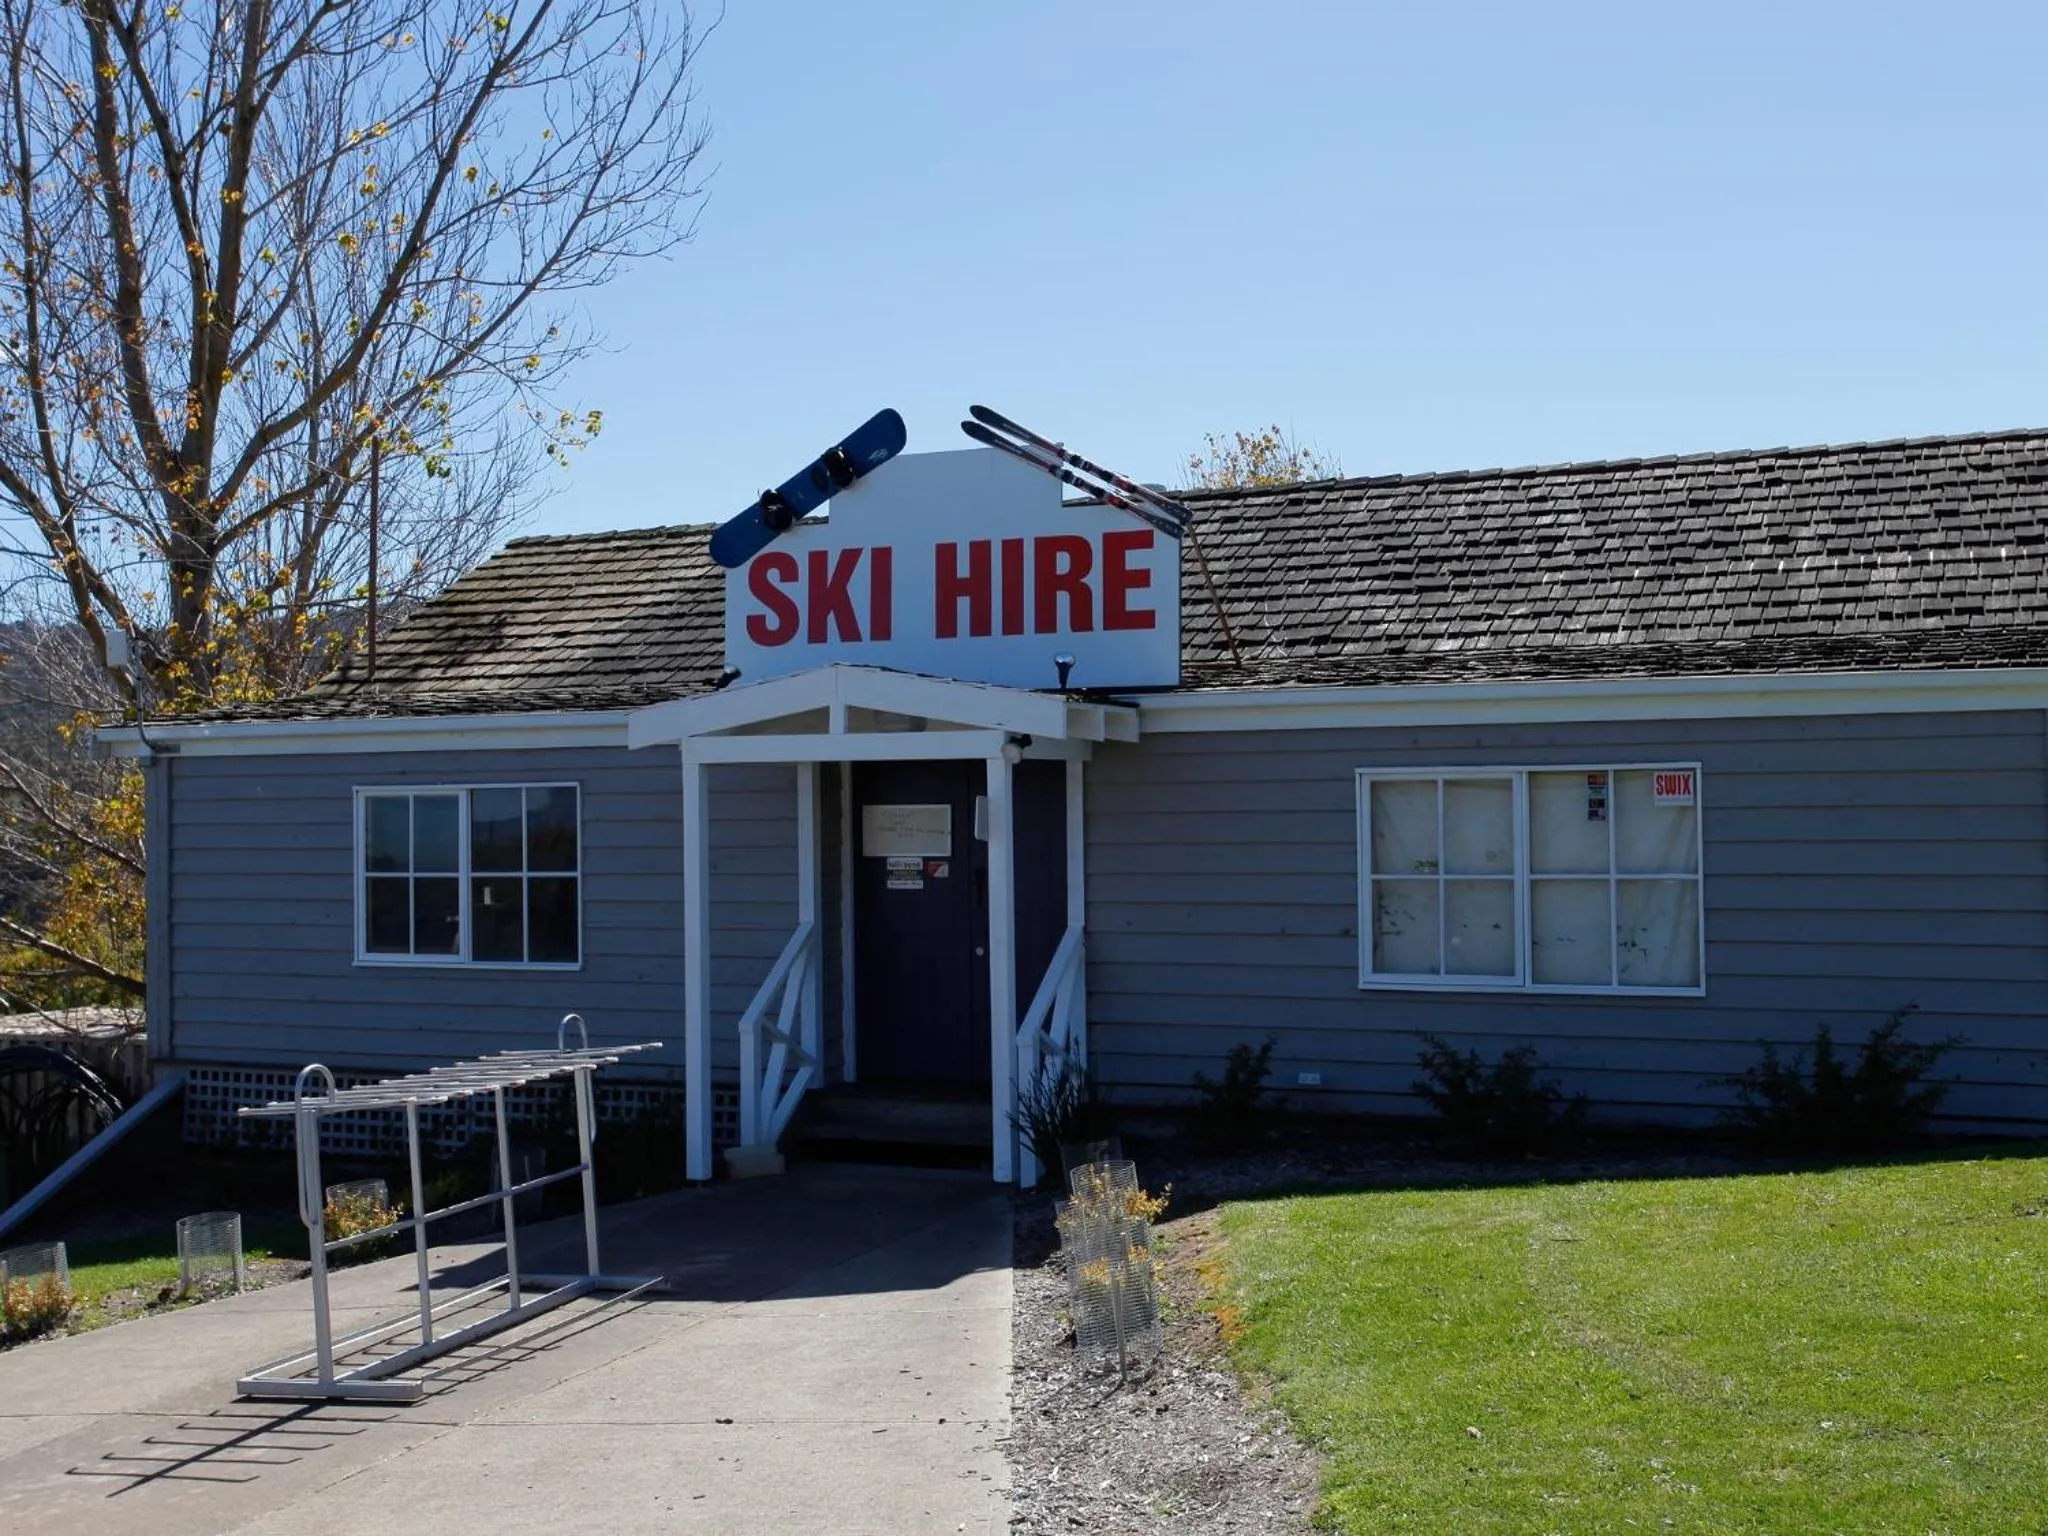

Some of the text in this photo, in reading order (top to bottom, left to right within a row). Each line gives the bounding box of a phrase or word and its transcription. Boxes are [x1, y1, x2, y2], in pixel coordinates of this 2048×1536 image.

[746, 529, 1156, 647] SKI HIRE
[1656, 774, 1691, 796] SWIX
